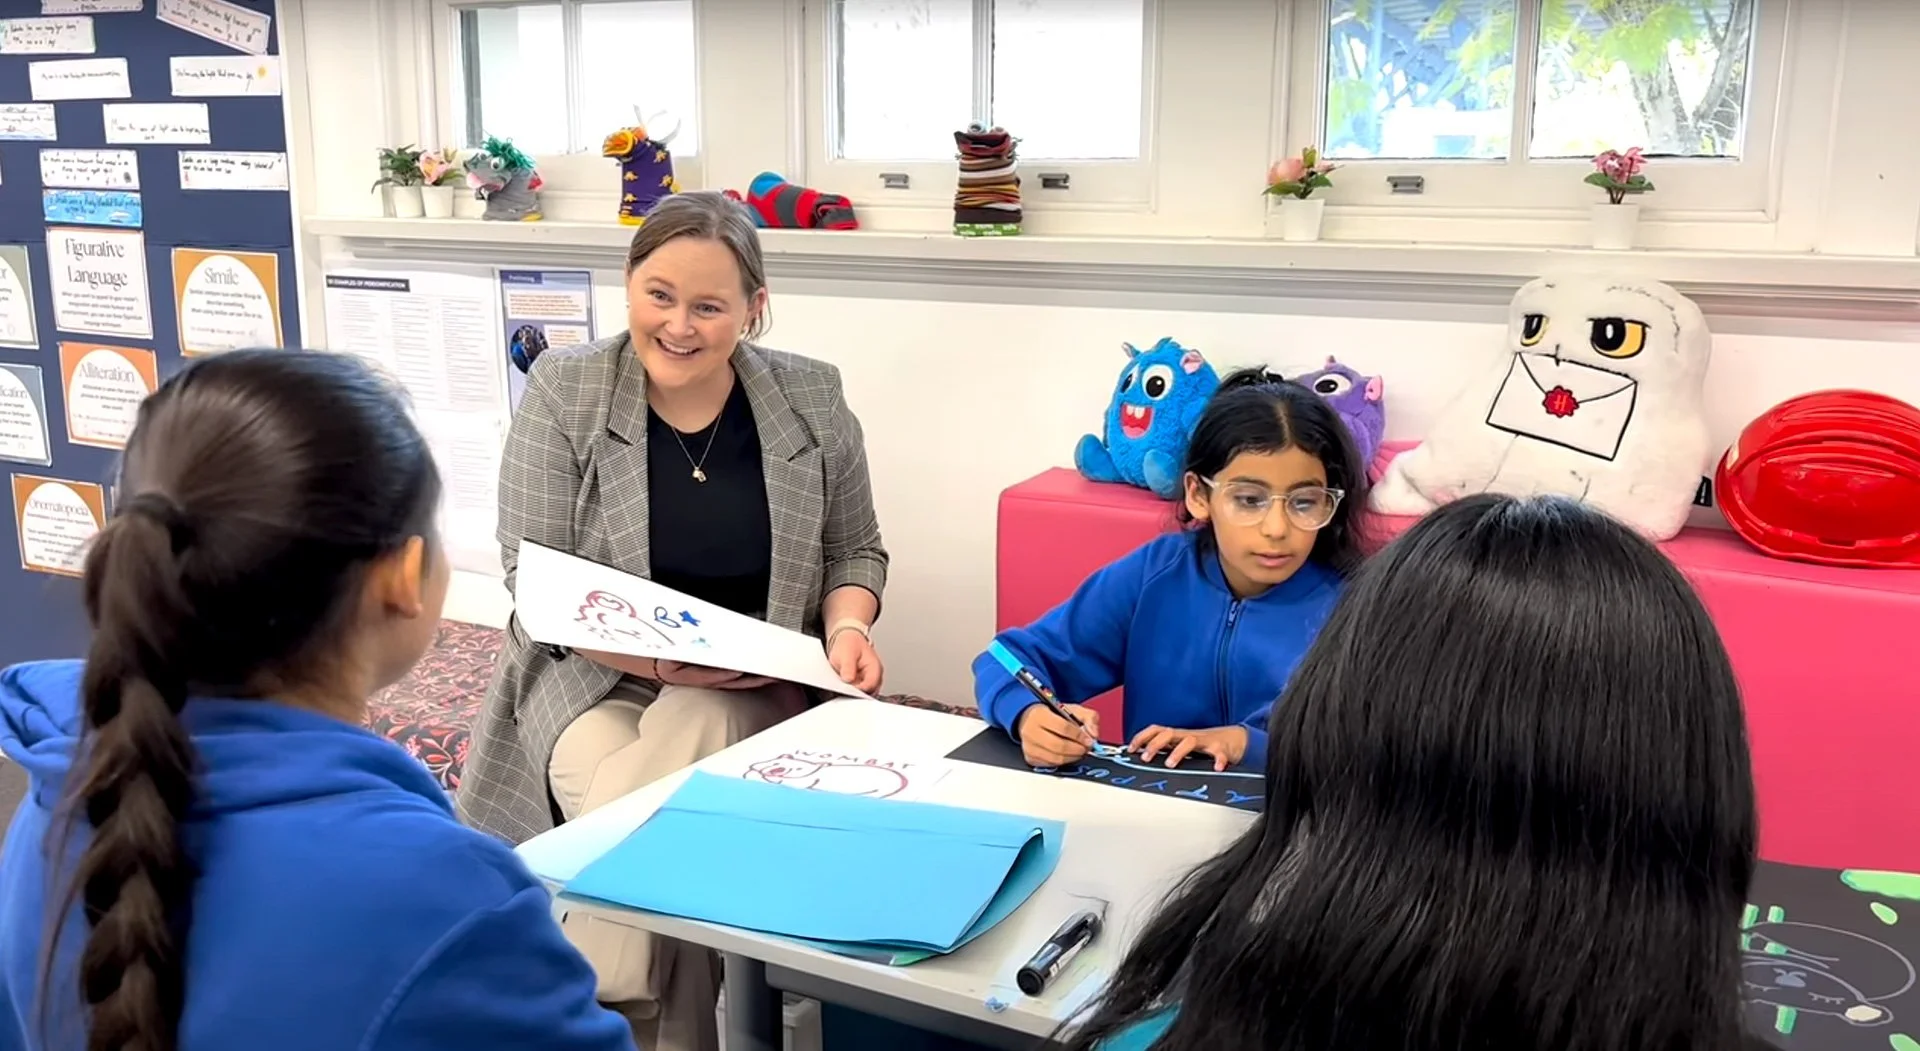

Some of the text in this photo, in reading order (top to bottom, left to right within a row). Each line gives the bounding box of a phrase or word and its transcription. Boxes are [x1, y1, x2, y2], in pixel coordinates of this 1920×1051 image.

[65, 238, 125, 261] Figurative
[68, 265, 128, 291] Language
[204, 266, 239, 285] Simile
[79, 361, 135, 384] Alliteration
[28, 499, 89, 517] Onomatopoeia
[794, 749, 917, 769] WOMBAT
[1060, 764, 1266, 804] ATYPUS
